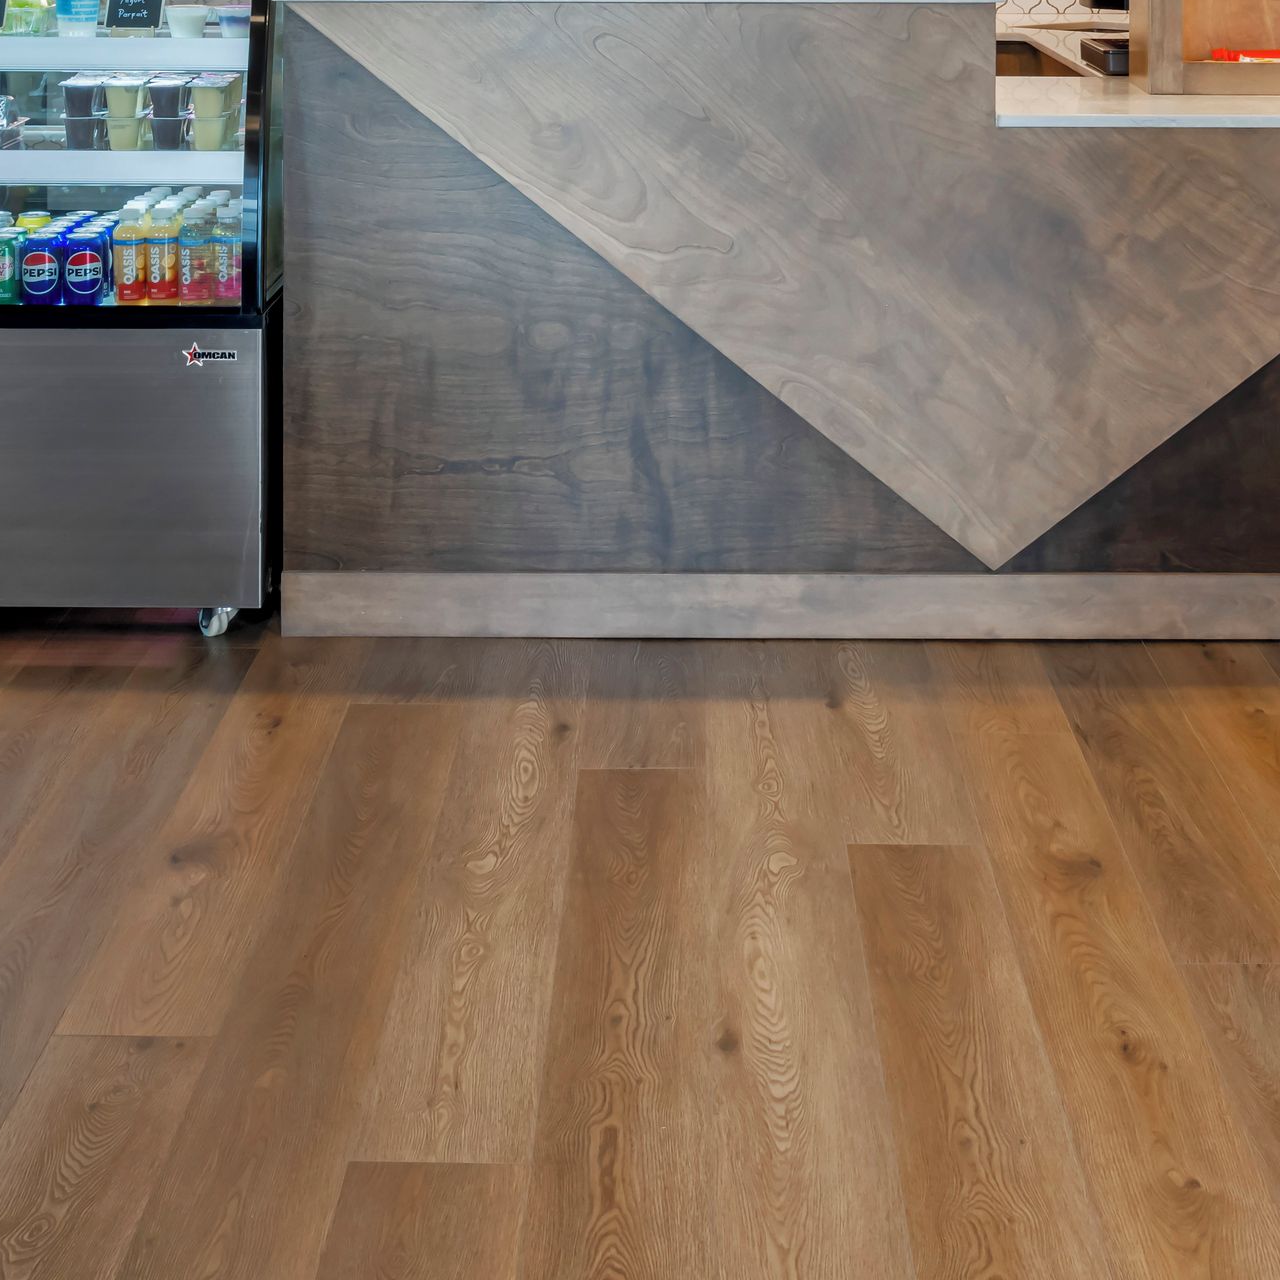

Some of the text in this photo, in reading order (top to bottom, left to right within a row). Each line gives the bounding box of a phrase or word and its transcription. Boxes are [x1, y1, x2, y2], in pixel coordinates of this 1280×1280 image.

[23, 266, 58, 278] PEPSI
[67, 266, 103, 278] PEPSI
[123, 249, 134, 285] OASIS
[150, 246, 161, 284] OASIS
[181, 248, 192, 285] OASIS
[218, 245, 229, 282] OASIS
[193, 351, 236, 360] OMCAN
